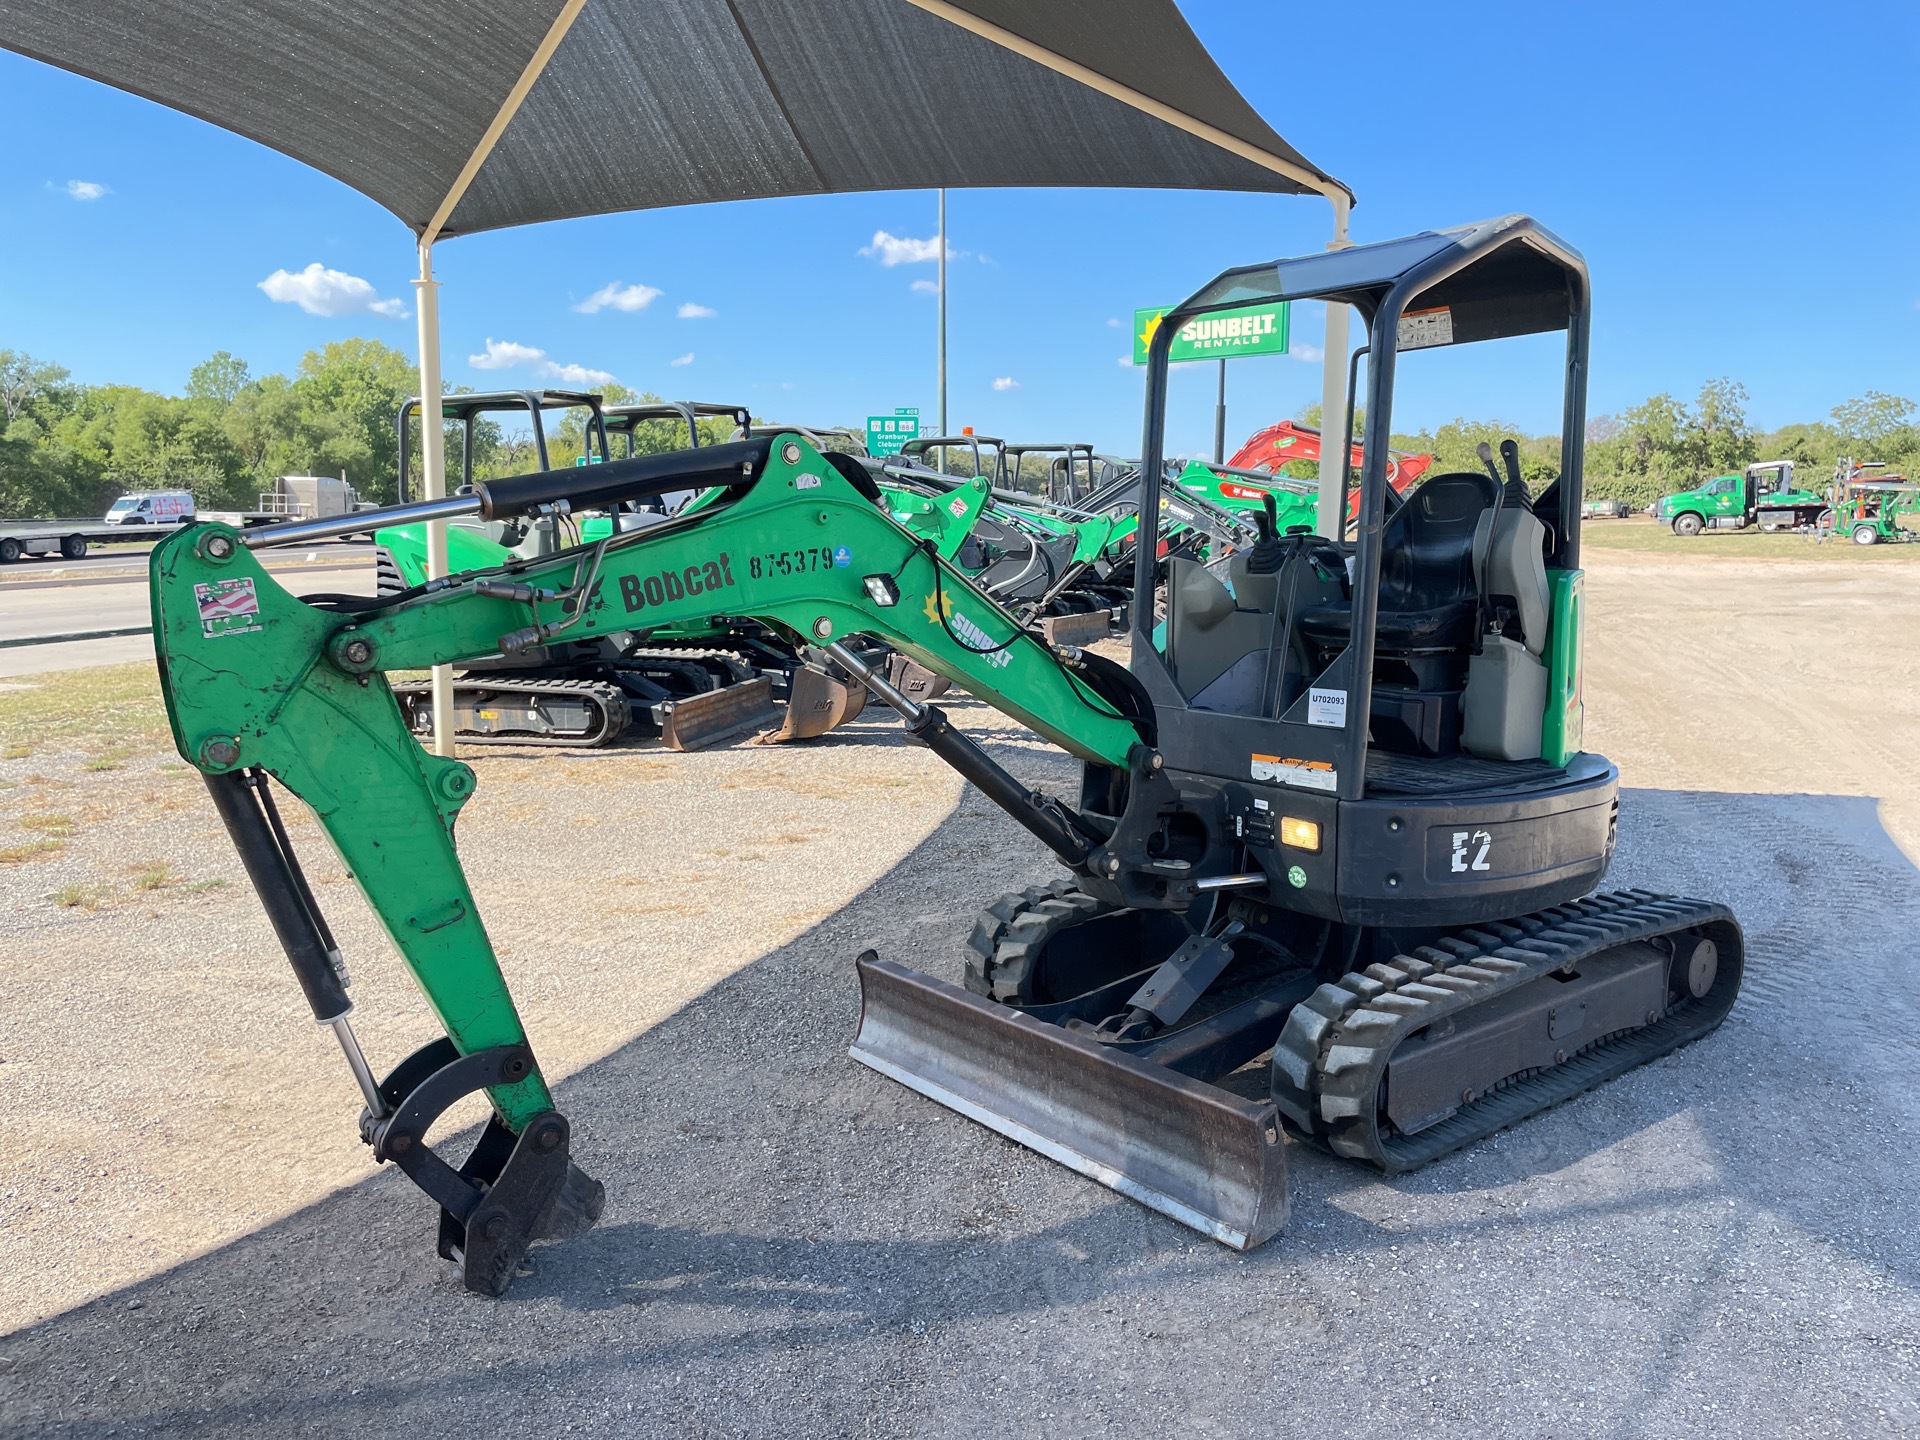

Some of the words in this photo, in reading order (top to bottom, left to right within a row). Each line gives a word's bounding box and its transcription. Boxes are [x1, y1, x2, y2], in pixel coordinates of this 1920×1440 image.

[1182, 314, 1275, 341] SUNBELT
[1194, 336, 1260, 349] RENTALS
[877, 433, 908, 441] Granbury
[1242, 489, 1261, 498] Bobcat
[618, 552, 735, 614] Bobcat
[1312, 695, 1345, 705] U702093
[1451, 830, 1492, 873] E2
